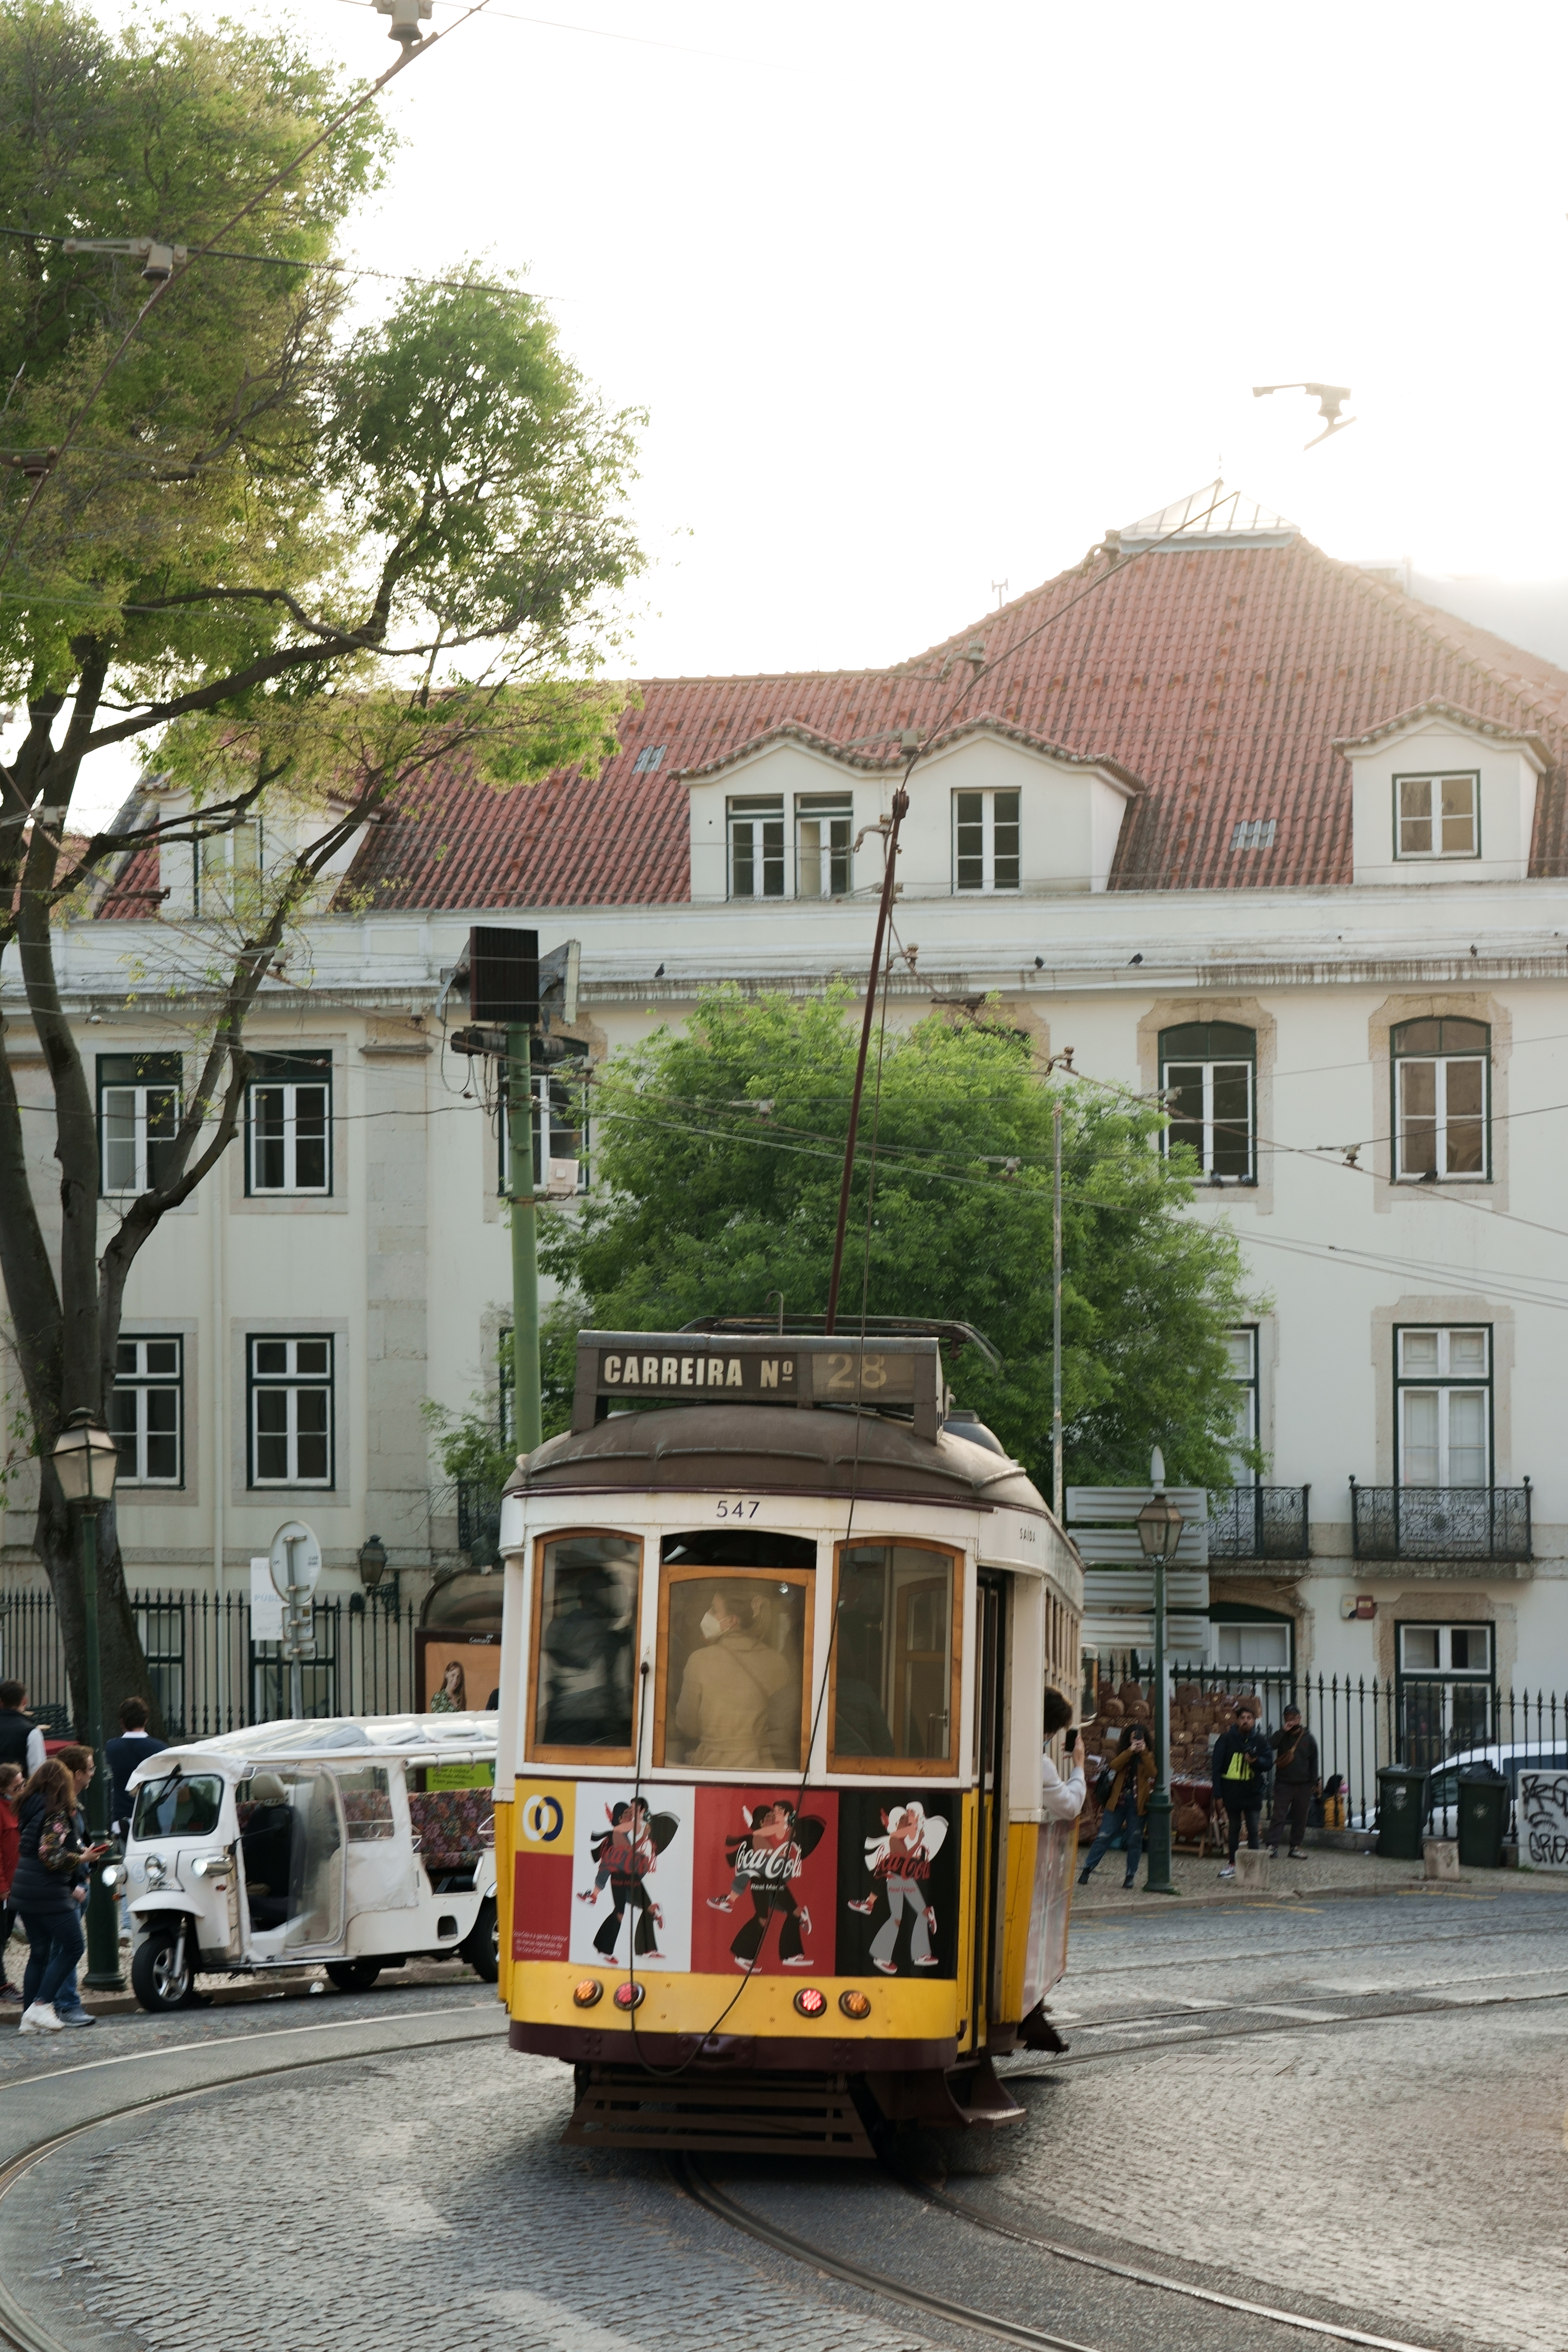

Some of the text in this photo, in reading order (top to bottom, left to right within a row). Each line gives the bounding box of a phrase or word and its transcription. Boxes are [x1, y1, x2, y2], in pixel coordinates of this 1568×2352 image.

[604, 1353, 887, 1389] CARREIRA Nº 28
[716, 1499, 760, 1519] 547
[1019, 1525, 1036, 1543] SAÍDA
[735, 1840, 802, 1879] Coca-Cola
[750, 1883, 765, 1891] Real
